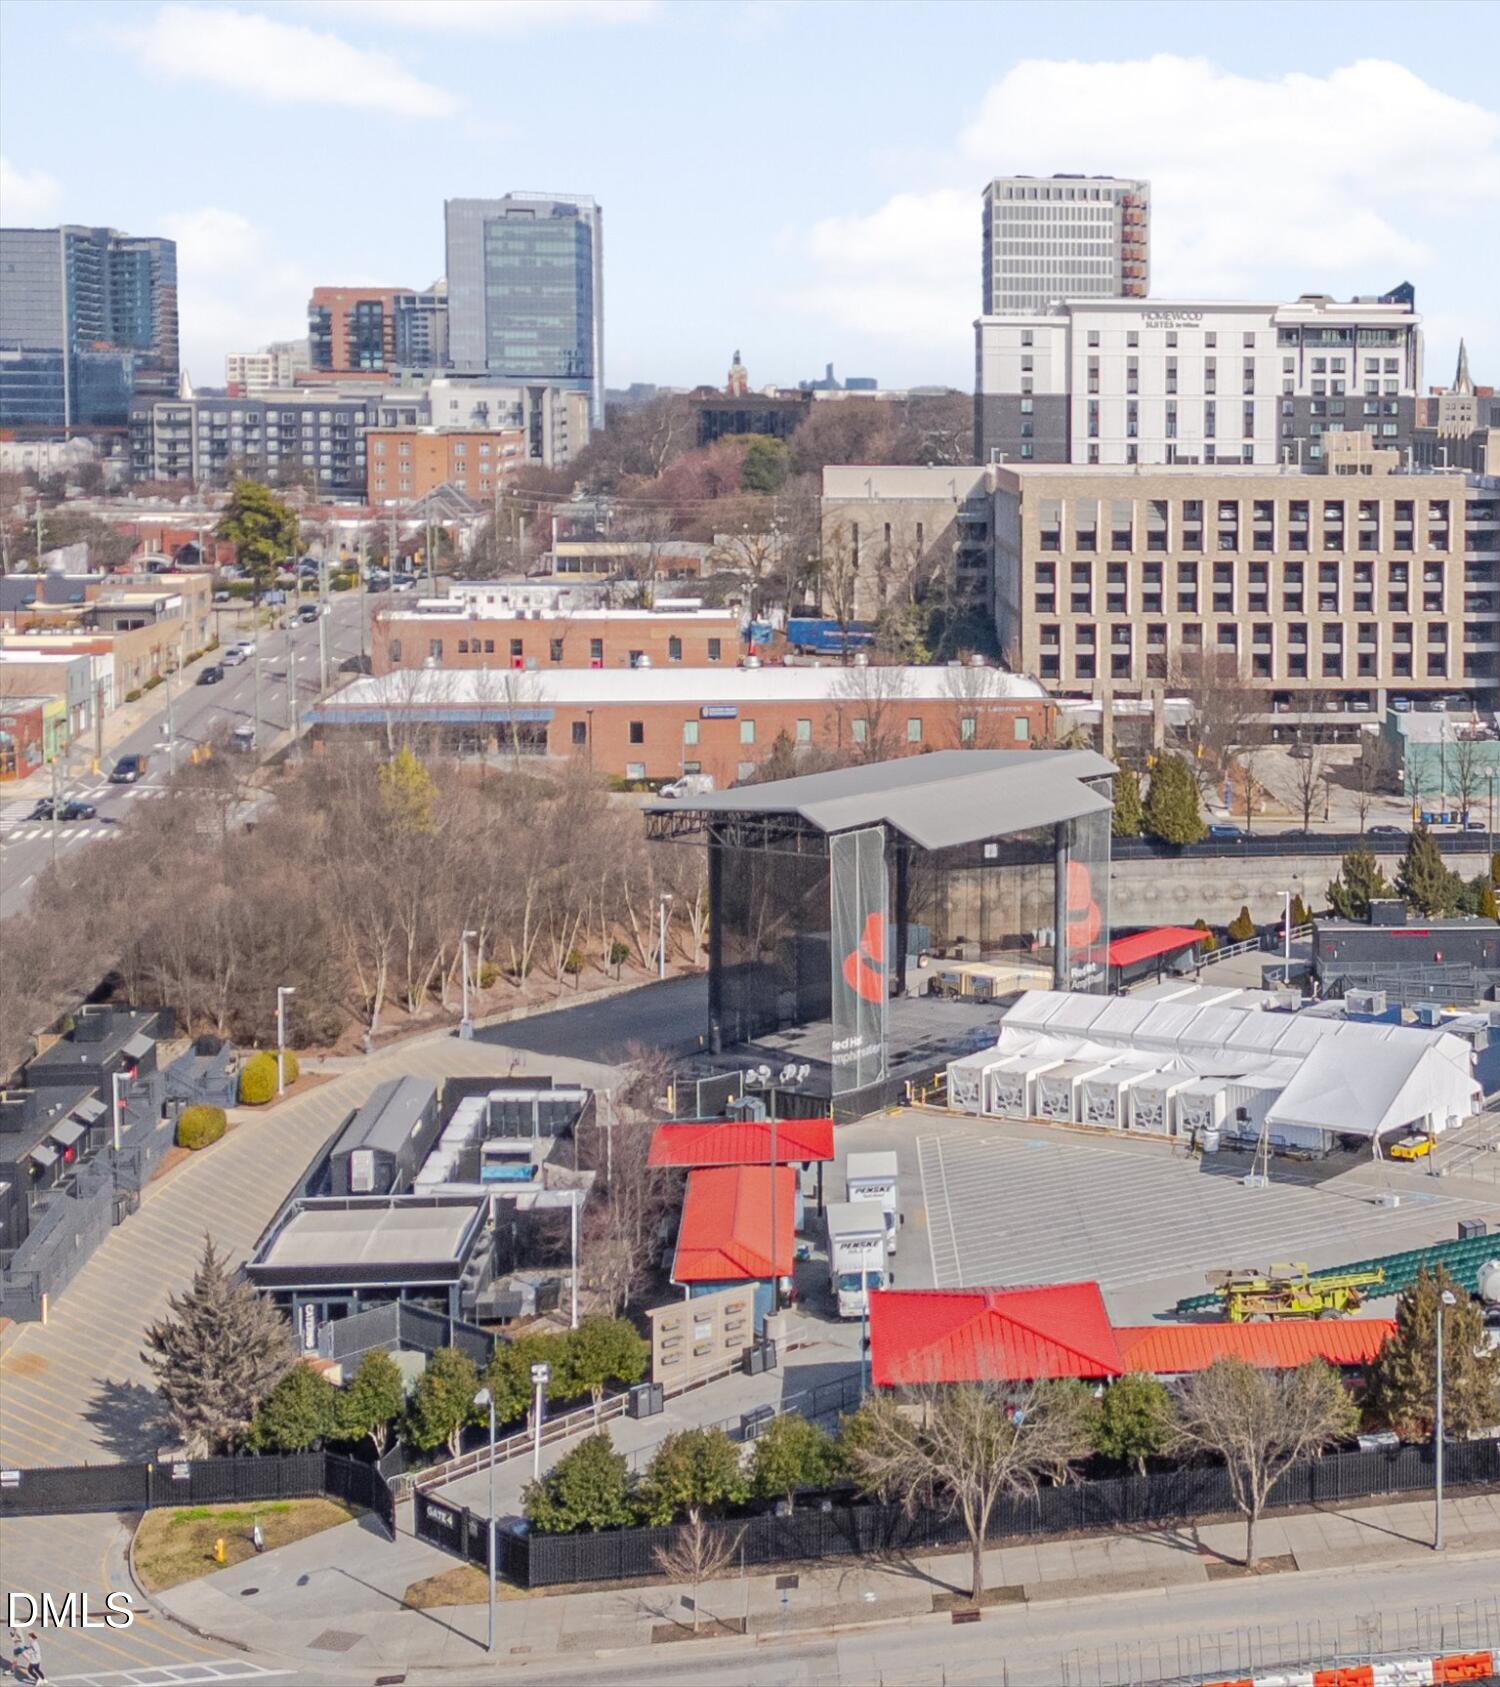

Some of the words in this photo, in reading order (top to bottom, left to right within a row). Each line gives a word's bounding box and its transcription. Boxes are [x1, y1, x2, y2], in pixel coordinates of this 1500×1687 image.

[1141, 311, 1203, 320] HOMEWOOD
[855, 1186, 890, 1194] PENSKE
[840, 1241, 878, 1250] PENSKE
